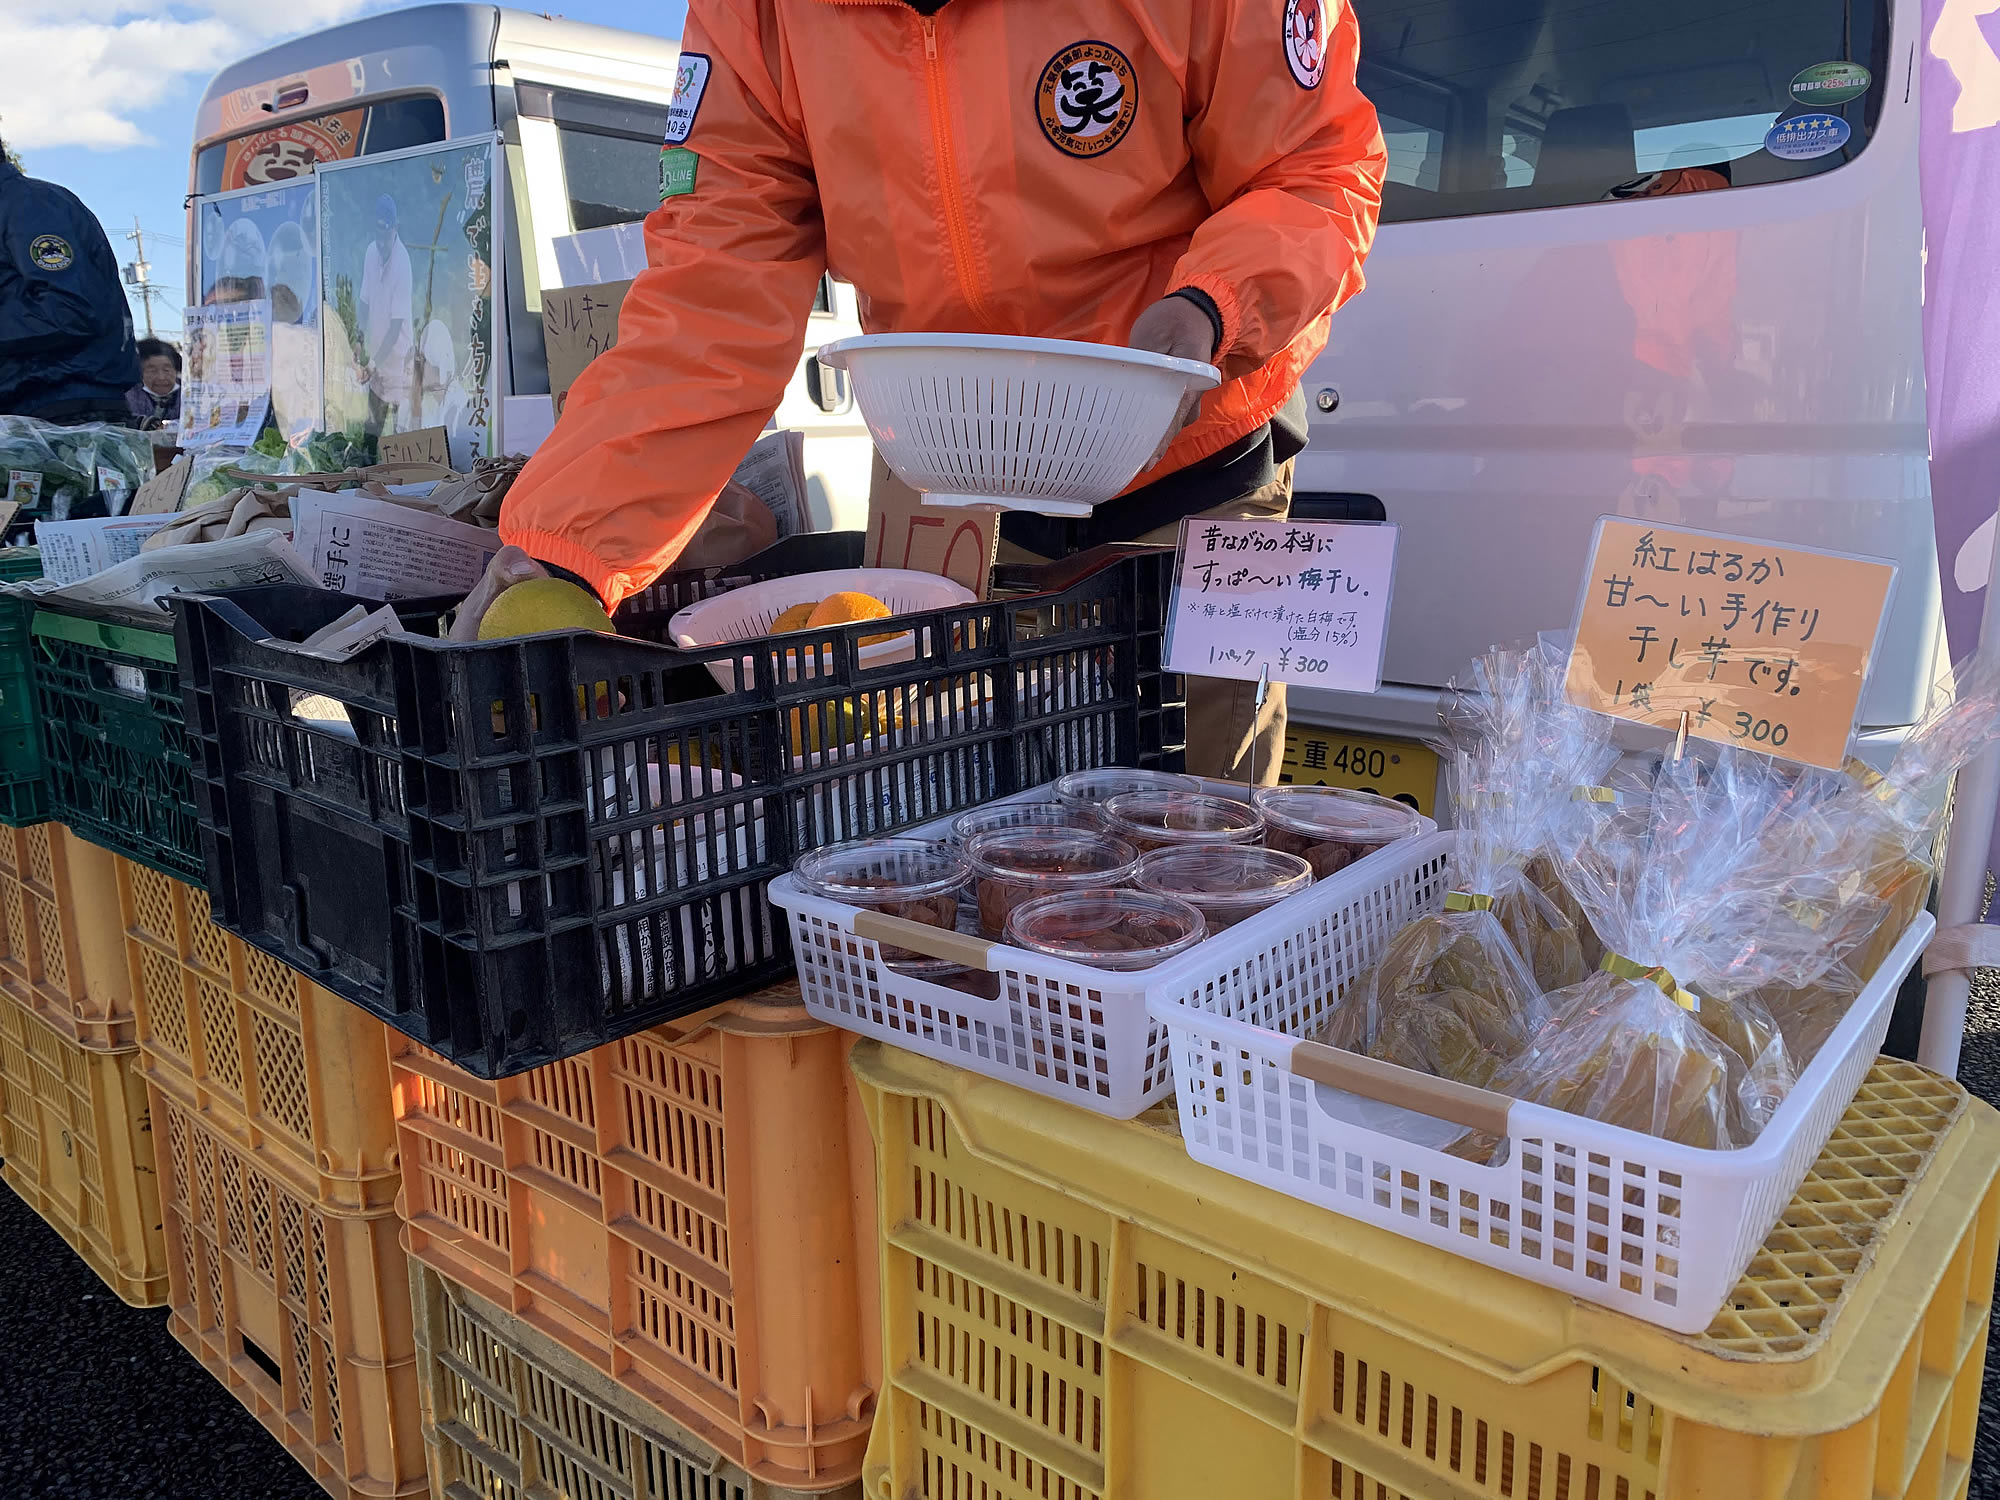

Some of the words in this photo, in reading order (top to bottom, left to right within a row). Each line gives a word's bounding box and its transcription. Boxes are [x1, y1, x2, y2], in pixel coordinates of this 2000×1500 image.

[1776, 127, 1839, 143] 低排出ガス車
[546, 293, 609, 336] ミルキー
[1201, 525, 1335, 554] 昔ながらの本当に
[1632, 530, 1785, 585] 紅はるか
[1209, 646, 1256, 666] 1パック
[1279, 646, 1330, 674] ¥300
[1628, 626, 1801, 697] 干し芋です。
